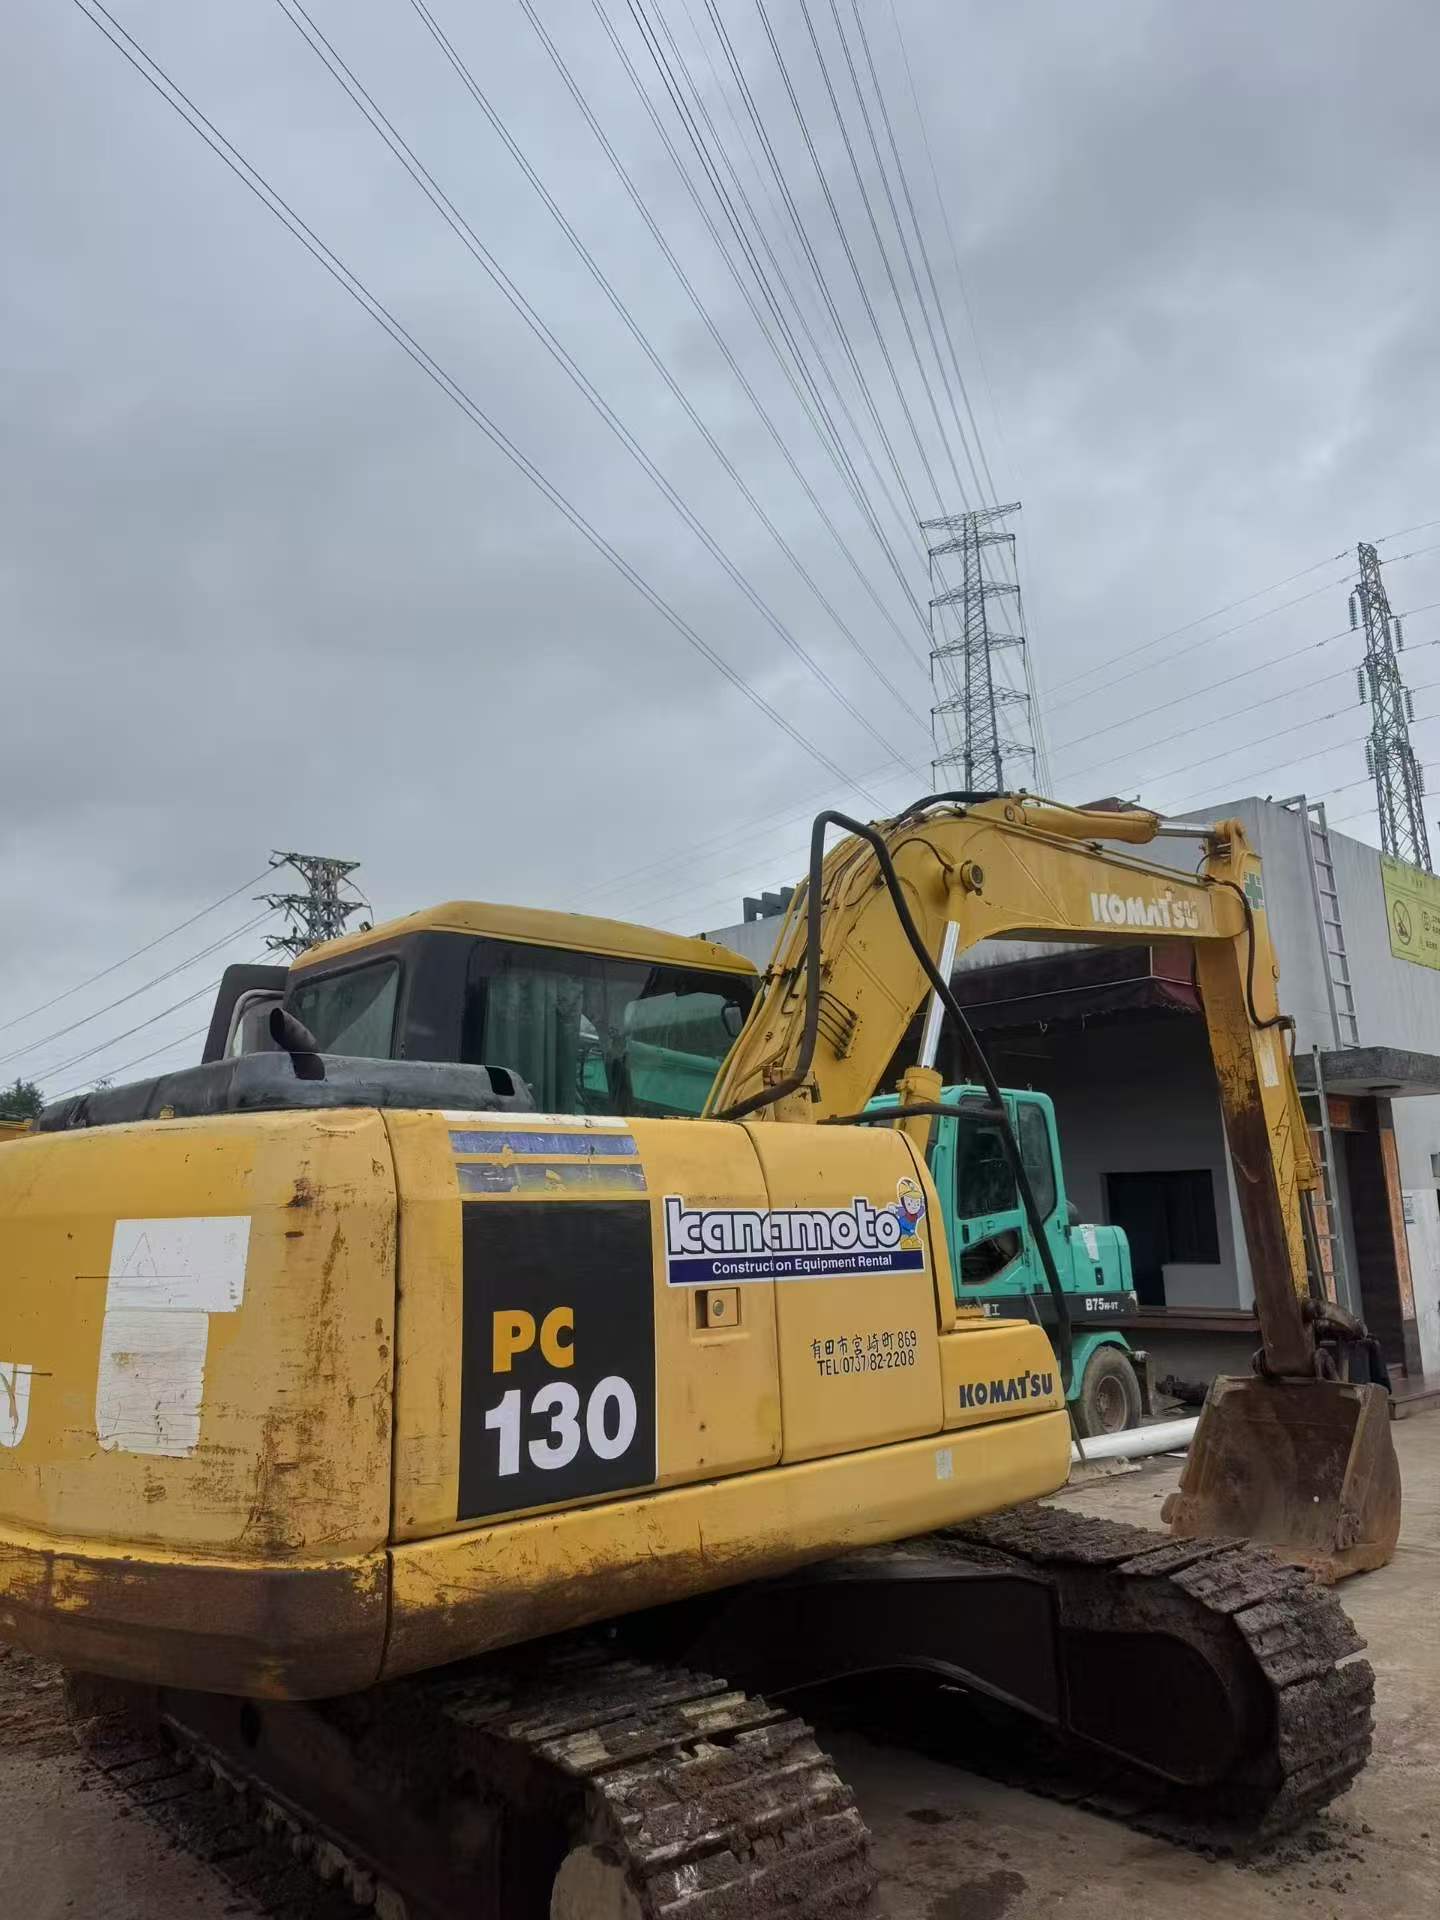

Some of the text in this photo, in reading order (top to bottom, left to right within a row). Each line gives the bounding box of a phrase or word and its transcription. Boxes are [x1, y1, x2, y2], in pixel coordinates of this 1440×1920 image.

[1089, 891, 1199, 929] KOMATSU
[665, 1198, 901, 1255] kanamoto
[712, 1254, 892, 1275] Constructon Equipment Rental
[493, 1306, 575, 1373] PC
[959, 1370, 1053, 1408] KOMATSU
[485, 1375, 637, 1476] 130
